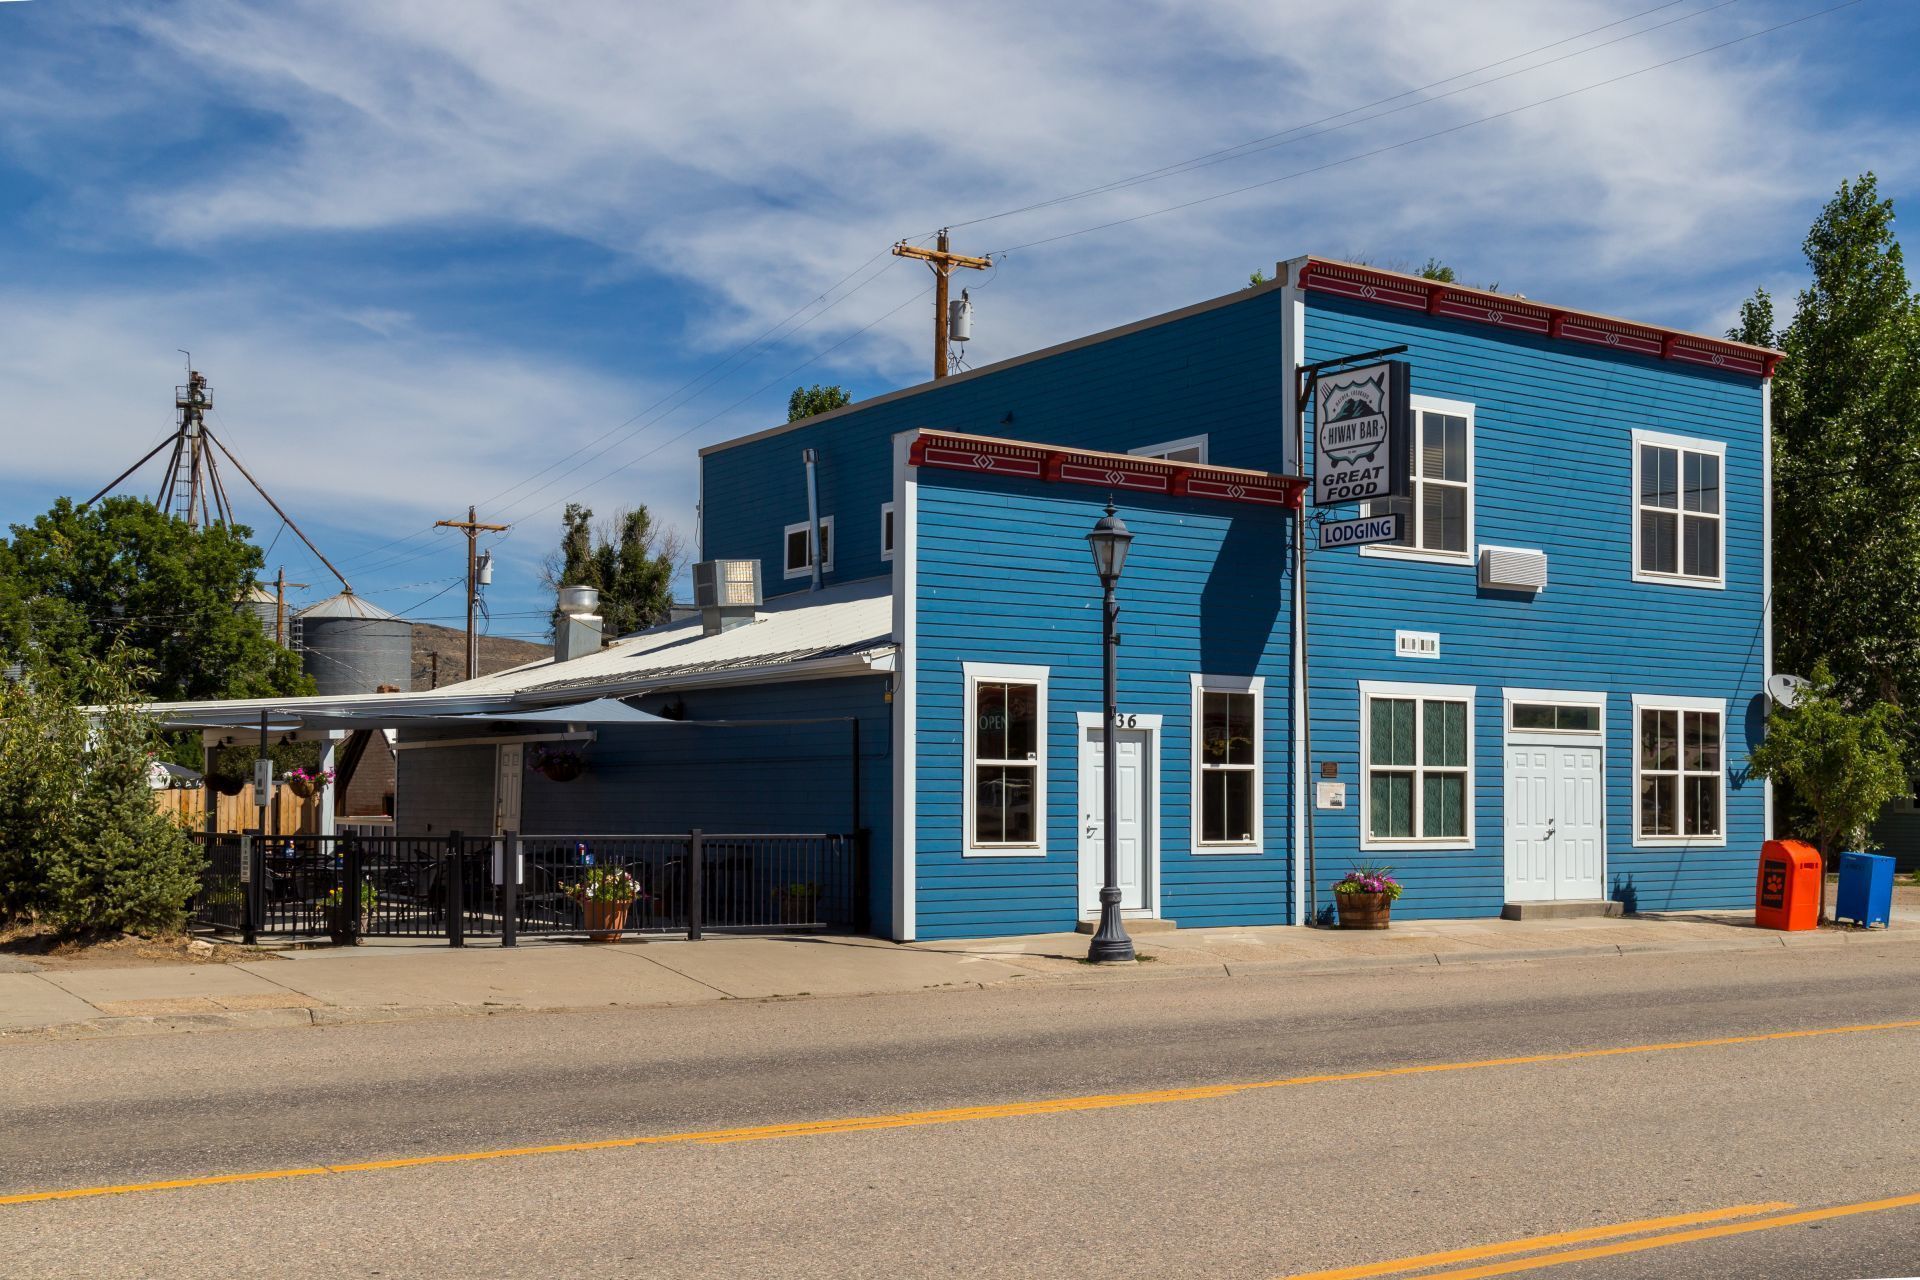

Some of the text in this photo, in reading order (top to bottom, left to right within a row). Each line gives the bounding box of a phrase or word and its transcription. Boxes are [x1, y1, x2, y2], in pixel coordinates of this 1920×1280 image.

[1328, 419, 1379, 445] HIWAY BAR
[1323, 466, 1385, 486] GREAT
[1327, 482, 1378, 500] FOOD
[1325, 520, 1391, 544] LODGING
[978, 713, 1009, 730] OPEN
